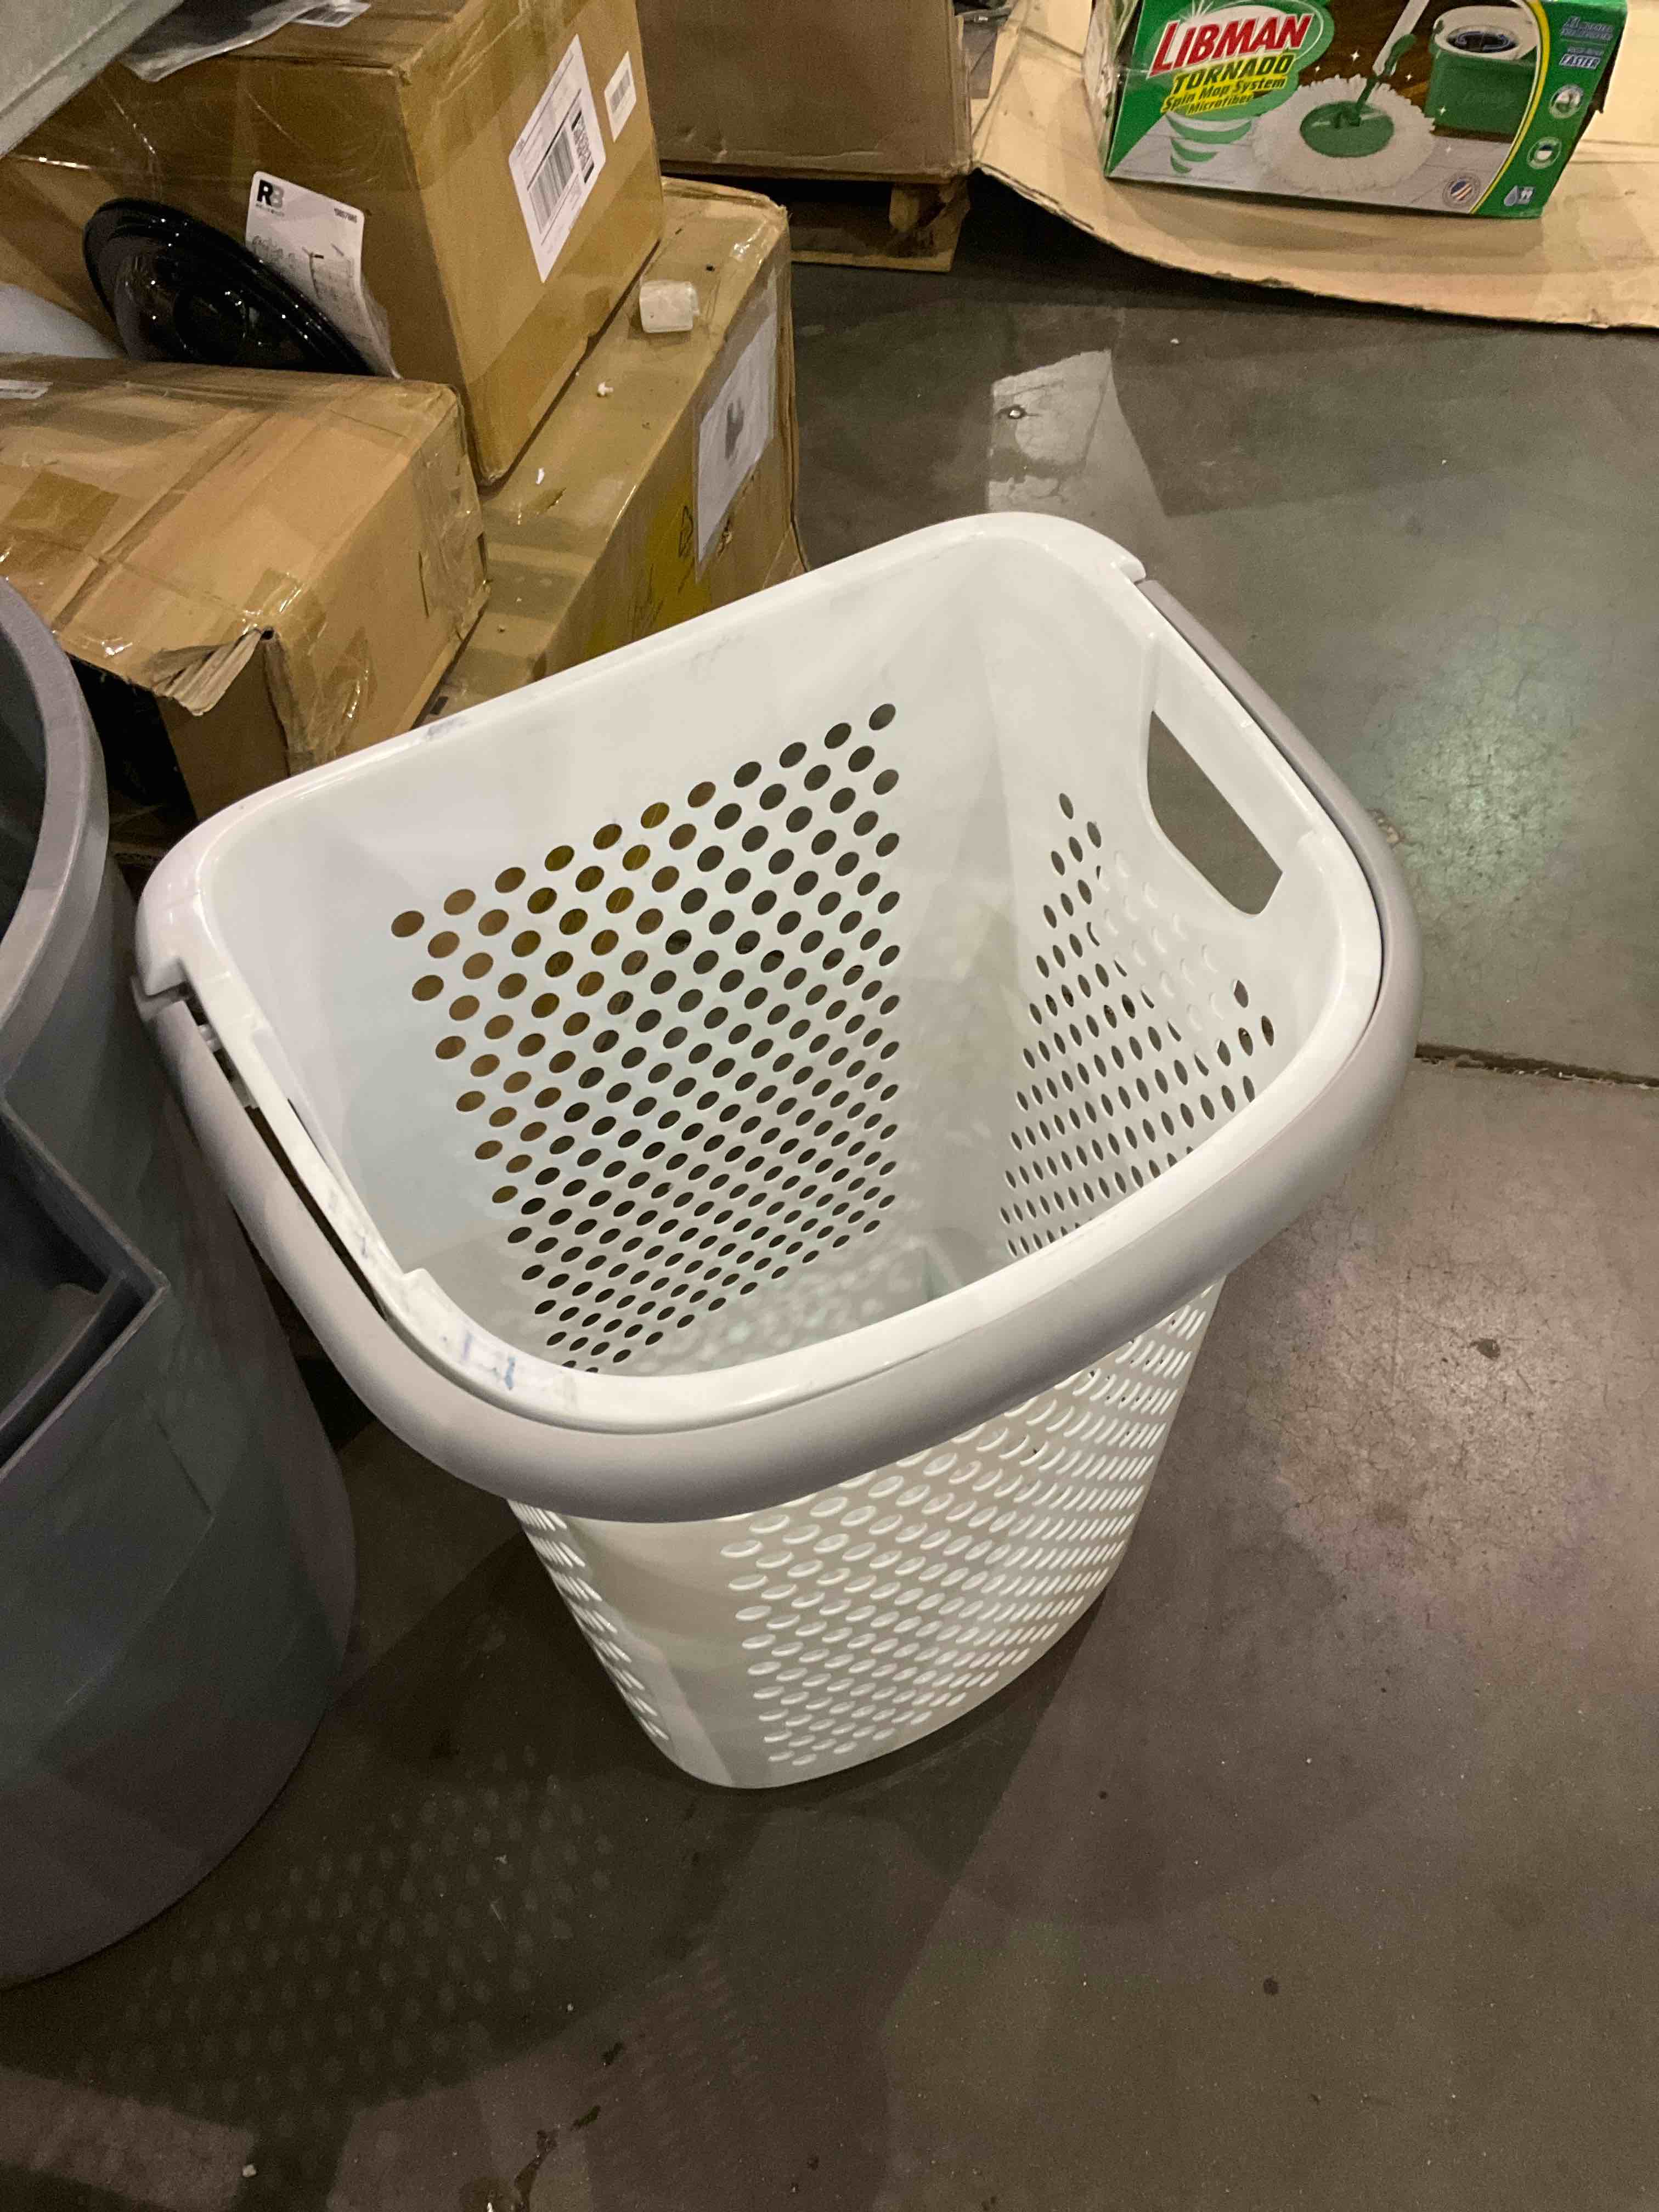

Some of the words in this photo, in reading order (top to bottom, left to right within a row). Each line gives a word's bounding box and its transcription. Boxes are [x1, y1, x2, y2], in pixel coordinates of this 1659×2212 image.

[1149, 14, 1313, 77] LIBMAN
[1172, 54, 1295, 95] TORNADO
[1164, 95, 1195, 111] Spin
[1201, 84, 1229, 100] Mop
[1234, 78, 1285, 94] System
[1189, 94, 1253, 114] Microfiber
